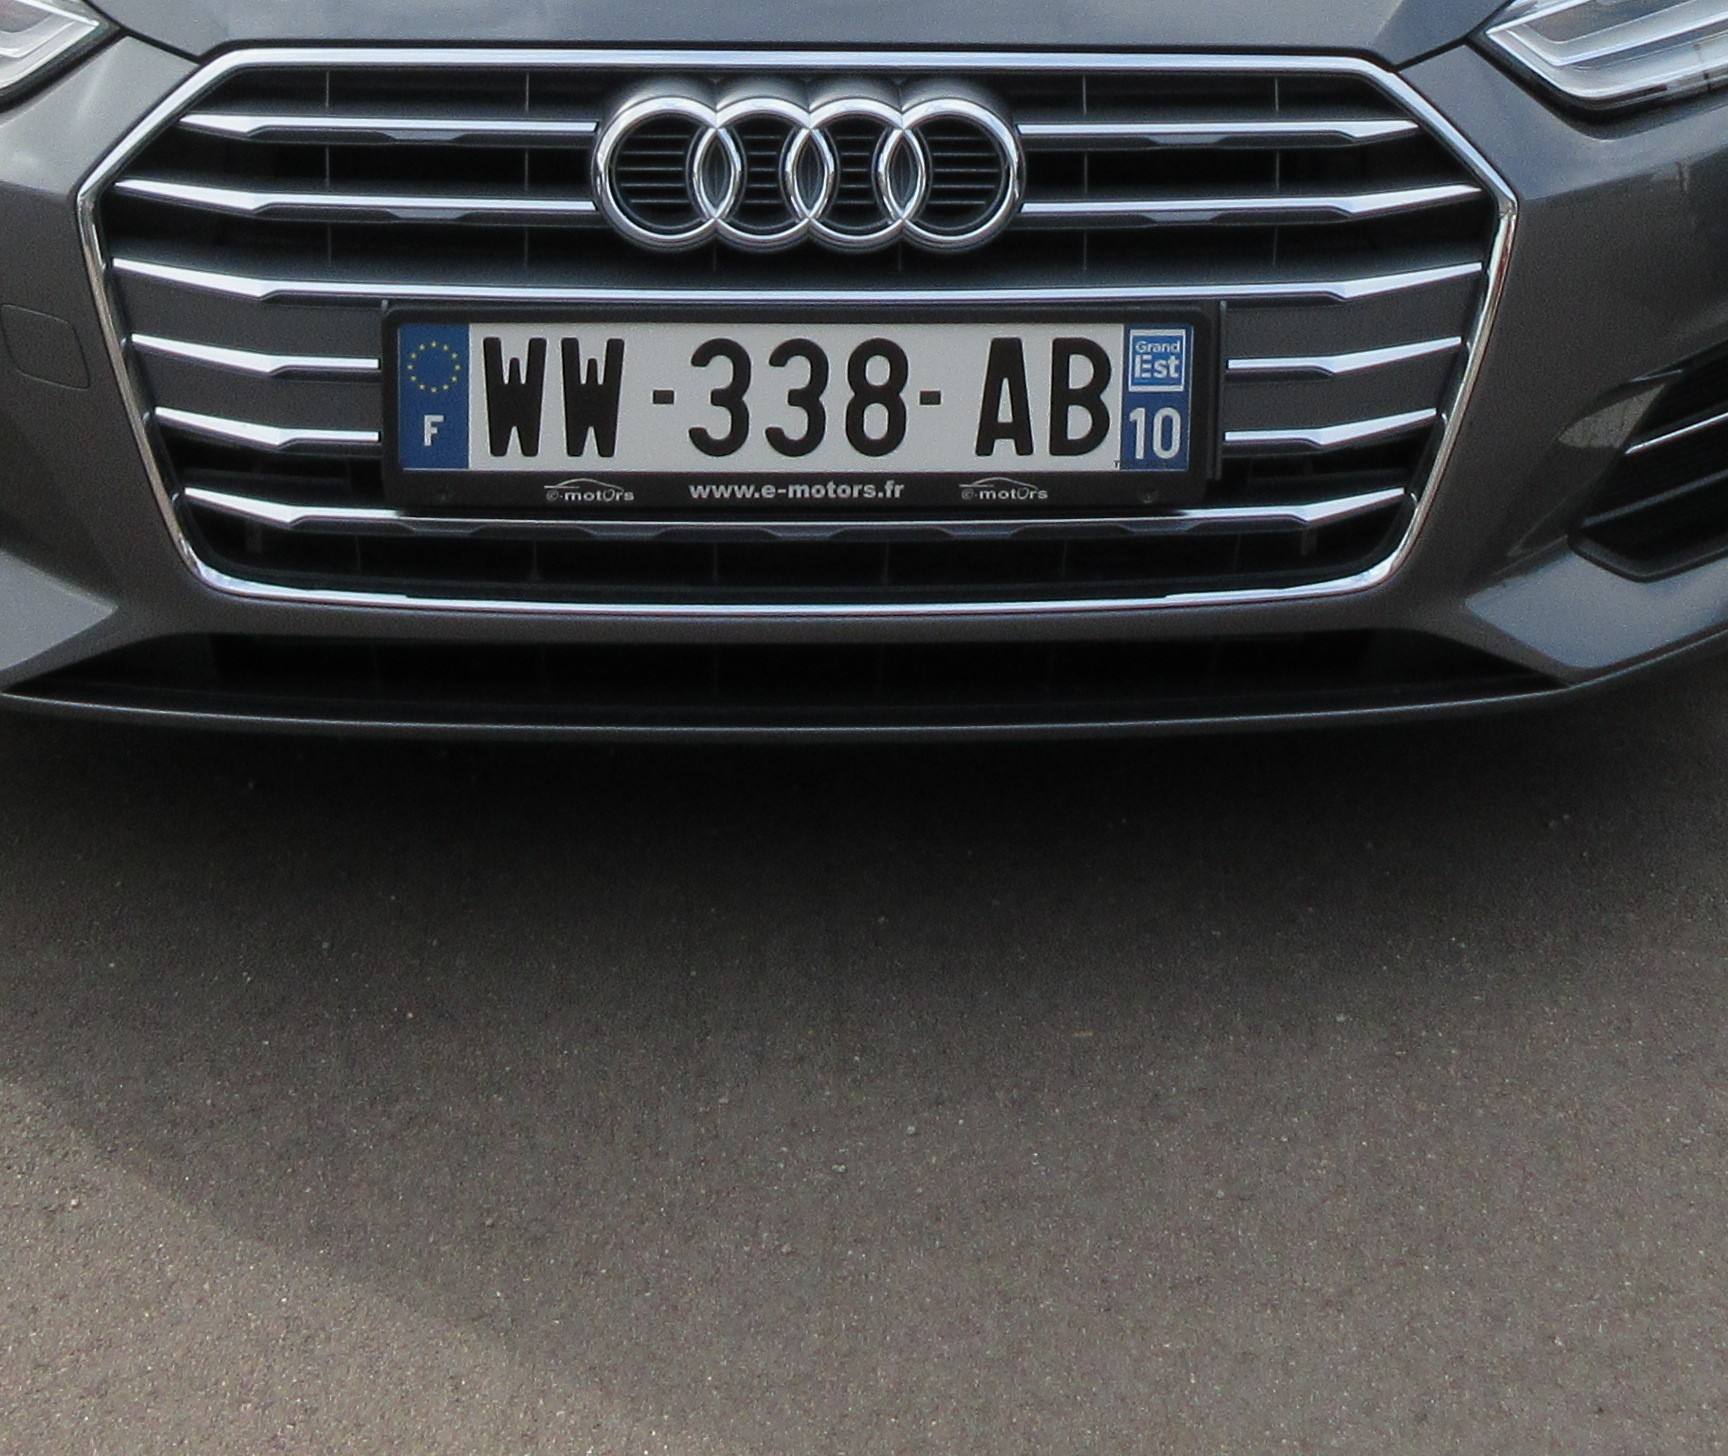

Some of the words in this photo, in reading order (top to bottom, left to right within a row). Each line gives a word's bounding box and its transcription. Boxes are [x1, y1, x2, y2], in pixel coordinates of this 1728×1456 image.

[1135, 340, 1182, 354] Grand
[1134, 354, 1180, 379] Est
[482, 336, 1112, 458] WW-338-AB
[423, 414, 445, 447] F
[1129, 406, 1182, 460] 10
[688, 479, 905, 500] www.e-motors.fr
